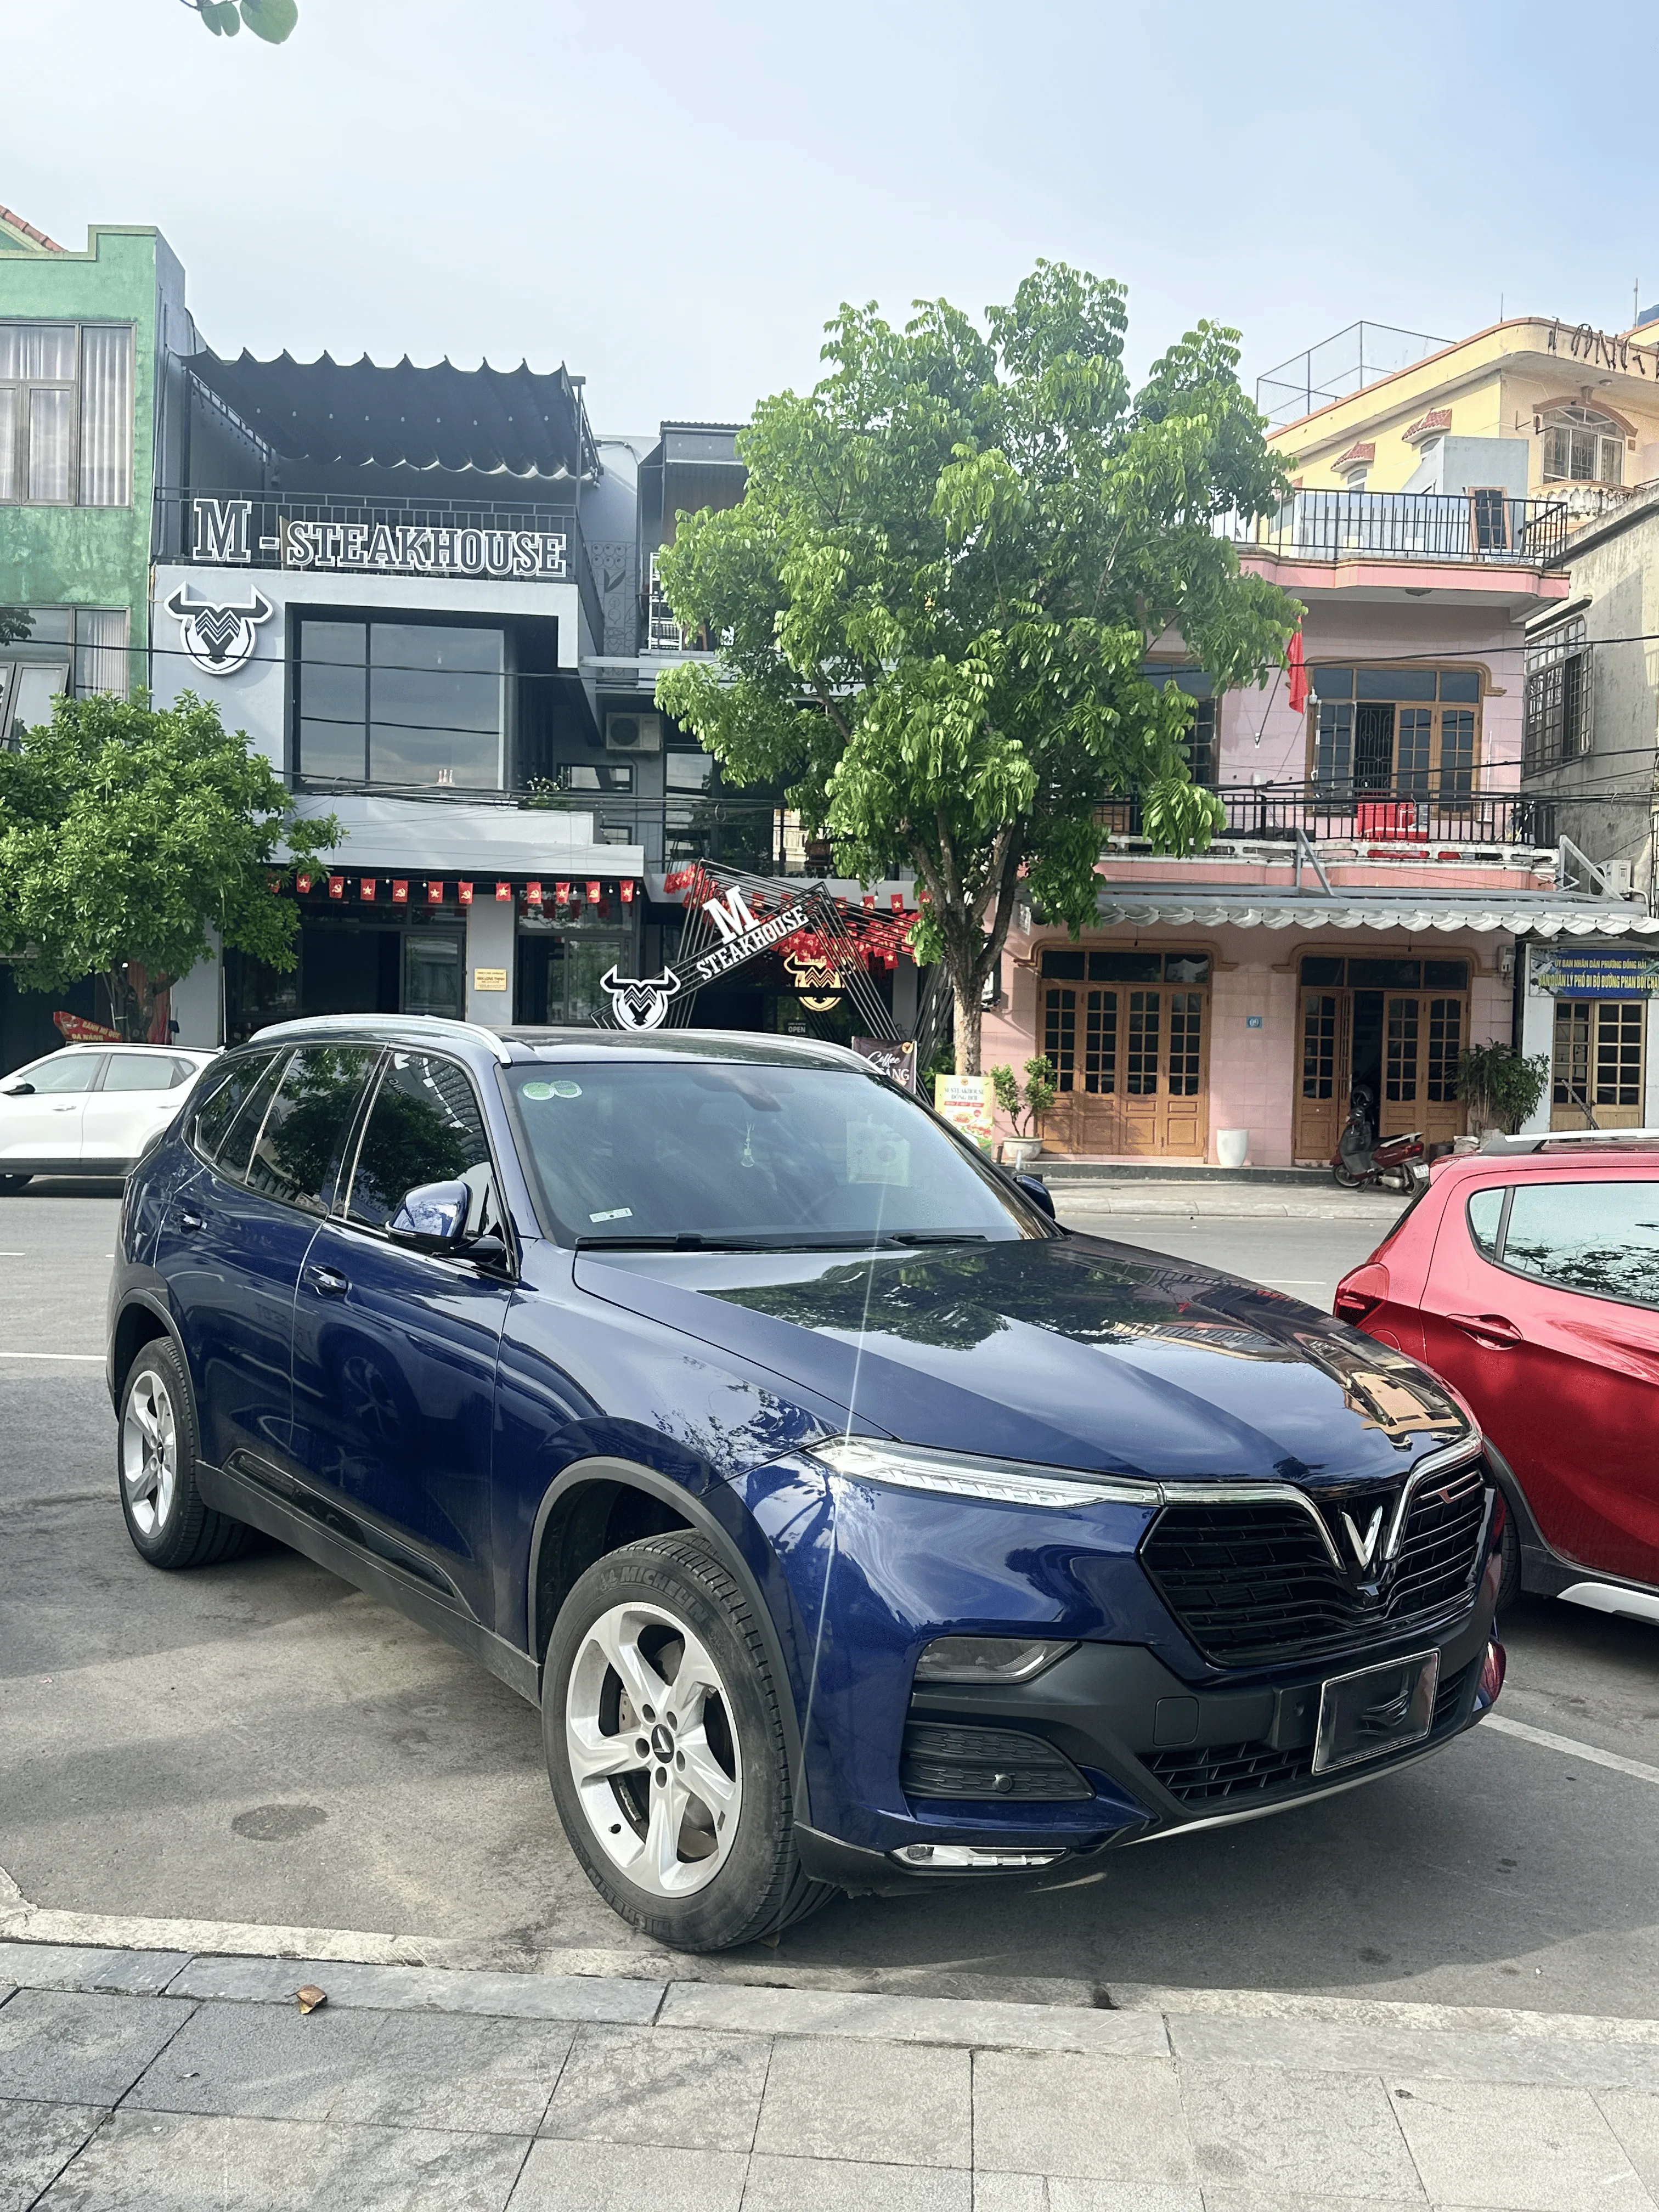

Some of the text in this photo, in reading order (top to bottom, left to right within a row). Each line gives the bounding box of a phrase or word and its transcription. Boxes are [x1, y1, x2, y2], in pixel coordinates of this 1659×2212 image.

[193, 498, 252, 563] M
[287, 521, 567, 578] STEAKHOUSE
[696, 905, 809, 980] STEAKHOUSE
[702, 885, 760, 944] M
[1562, 959, 1573, 968] BAN
[1621, 975, 1636, 989] PHAN
[867, 1051, 900, 1067] Coffee
[620, 1566, 711, 1630] MICHELIN
